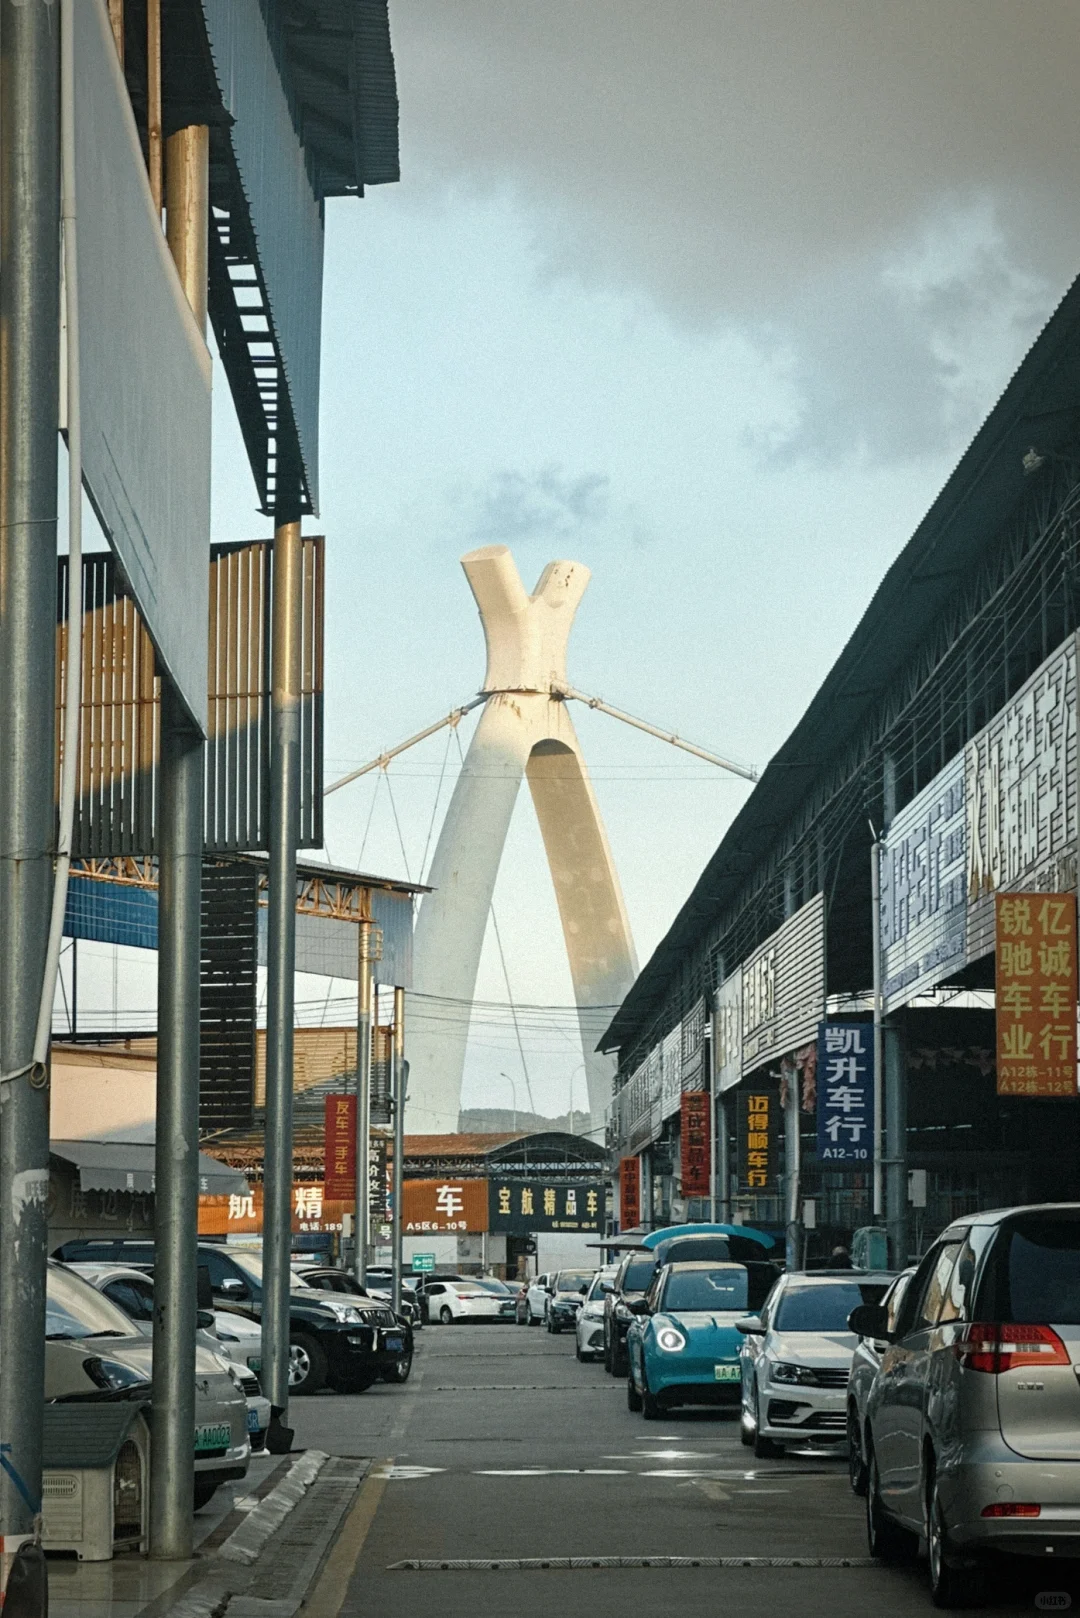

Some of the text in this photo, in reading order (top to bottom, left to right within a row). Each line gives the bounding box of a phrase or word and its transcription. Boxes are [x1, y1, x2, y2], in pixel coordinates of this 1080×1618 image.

[1000, 898, 1033, 1060] 锐驰车业
[1038, 898, 1074, 1061] 亿诚车行
[824, 1026, 866, 1143] 凯升车行
[335, 1100, 350, 1175] 友车二手车
[747, 1095, 768, 1187] 迈得顺车行
[823, 1148, 868, 1160] A12-10
[406, 1220, 468, 1231] A5区6-10号
[498, 1186, 598, 1217] 宝航精品车
